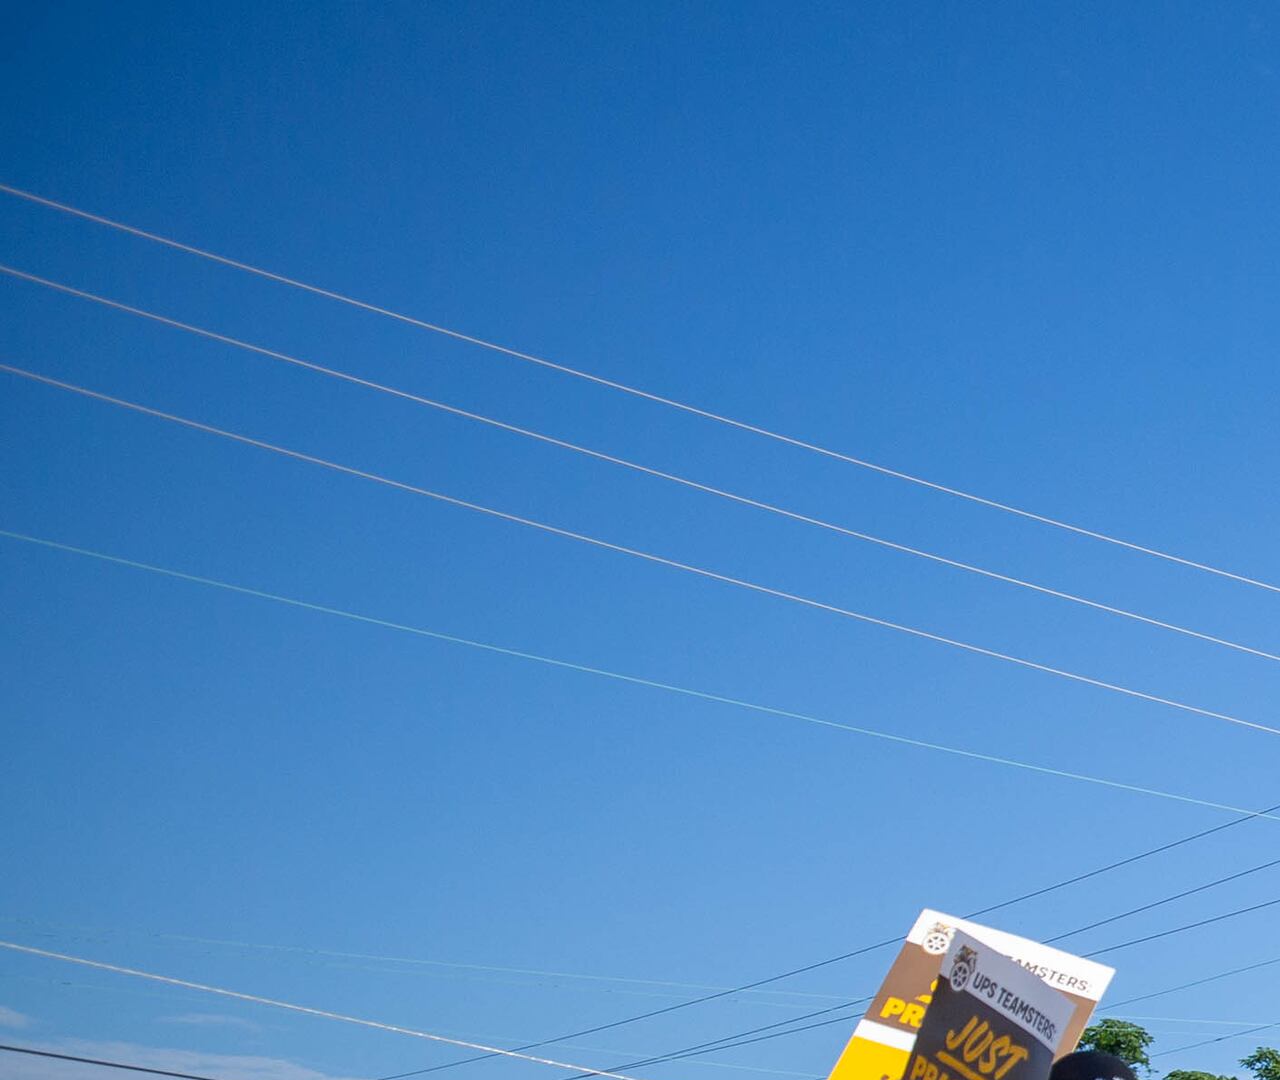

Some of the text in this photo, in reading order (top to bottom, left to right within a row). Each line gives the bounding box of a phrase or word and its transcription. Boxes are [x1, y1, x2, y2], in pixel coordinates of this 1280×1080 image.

[972, 972, 998, 999] UPS
[999, 987, 1057, 1043] TEAMSTERS:
[945, 1015, 1029, 1080] JUST
